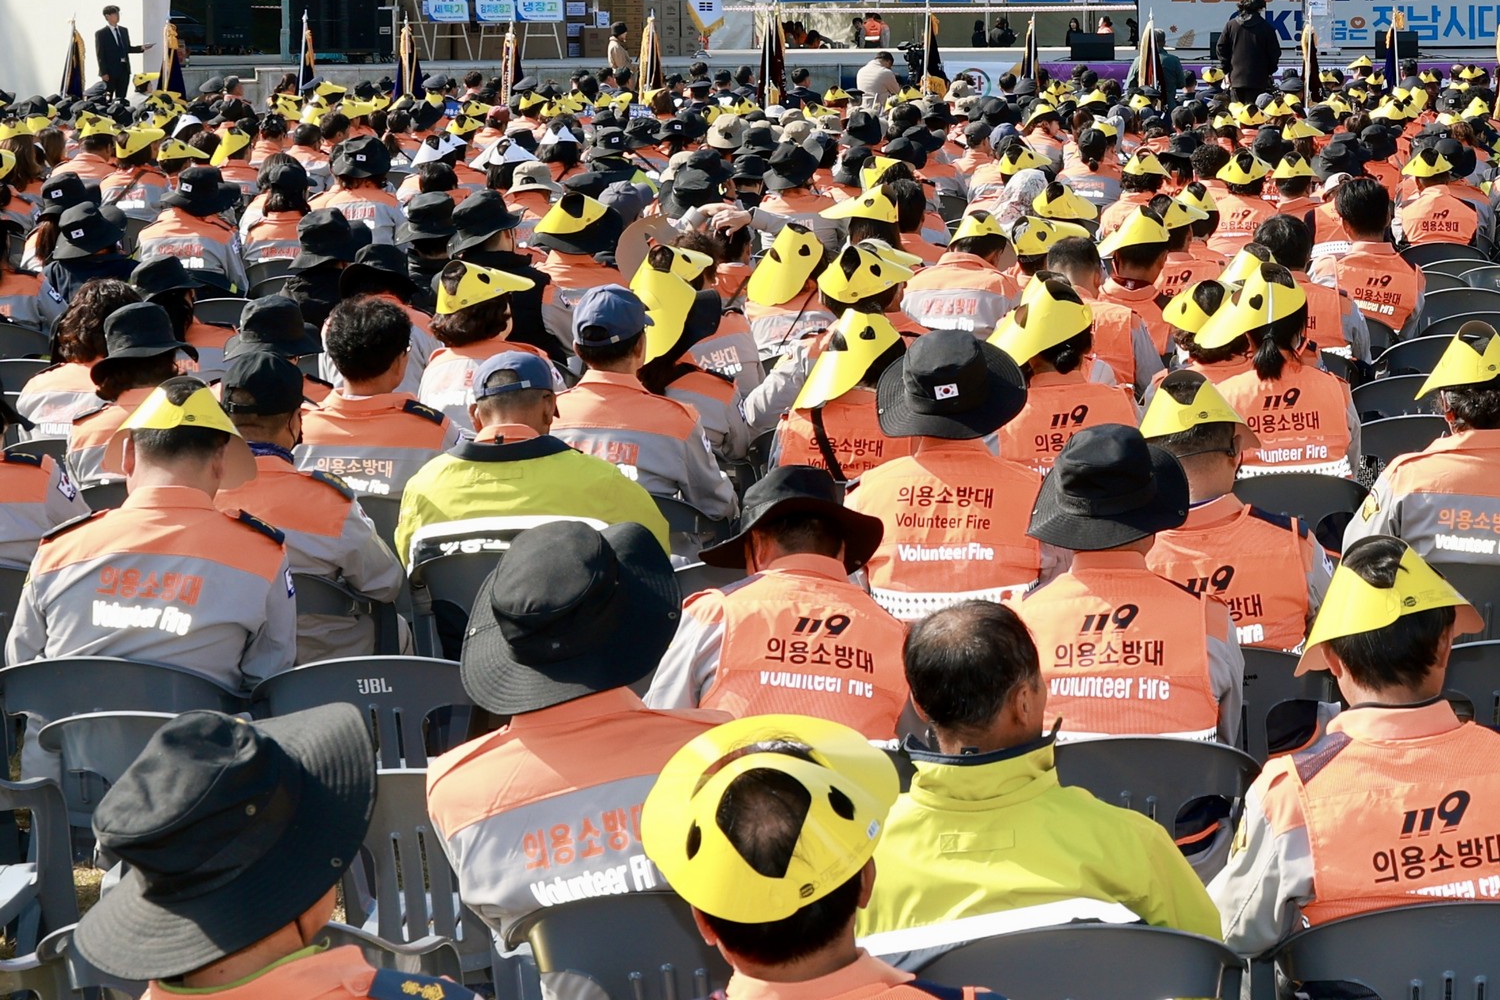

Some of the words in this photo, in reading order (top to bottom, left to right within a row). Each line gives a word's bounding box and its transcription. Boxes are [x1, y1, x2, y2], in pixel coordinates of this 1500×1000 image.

[434, 4, 465, 14] 세탁기
[523, 2, 556, 12] 냉장고
[1231, 210, 1250, 220] 119
[1434, 209, 1451, 219] 119
[1421, 220, 1460, 233] 의용소방대
[1166, 270, 1192, 285] 119
[1367, 275, 1392, 287] 119
[1354, 288, 1402, 304] 의용소방대
[1263, 388, 1300, 410] 119
[1051, 405, 1089, 429] 119
[1247, 411, 1320, 435] 의용소방대
[809, 435, 884, 459] 의용소방대
[1253, 446, 1303, 465] olunteer
[1305, 445, 1328, 460] Fire
[316, 457, 393, 478] 의용소방대
[898, 485, 995, 509] 의용소방대
[896, 513, 962, 529] Volunteer
[966, 515, 991, 530] Fire
[898, 543, 967, 561] Volunteer
[968, 545, 994, 562] Fire
[1435, 533, 1495, 555] Volunteer
[96, 566, 204, 605] 의용소방대
[1186, 565, 1236, 595] 119
[793, 614, 852, 638] 119
[1080, 604, 1140, 636] 119
[765, 637, 875, 675] 의용소방대
[1054, 638, 1164, 670] 의용소방대
[356, 678, 393, 695] JBL
[1400, 790, 1471, 838] 119
[530, 863, 629, 908] Volunteer
